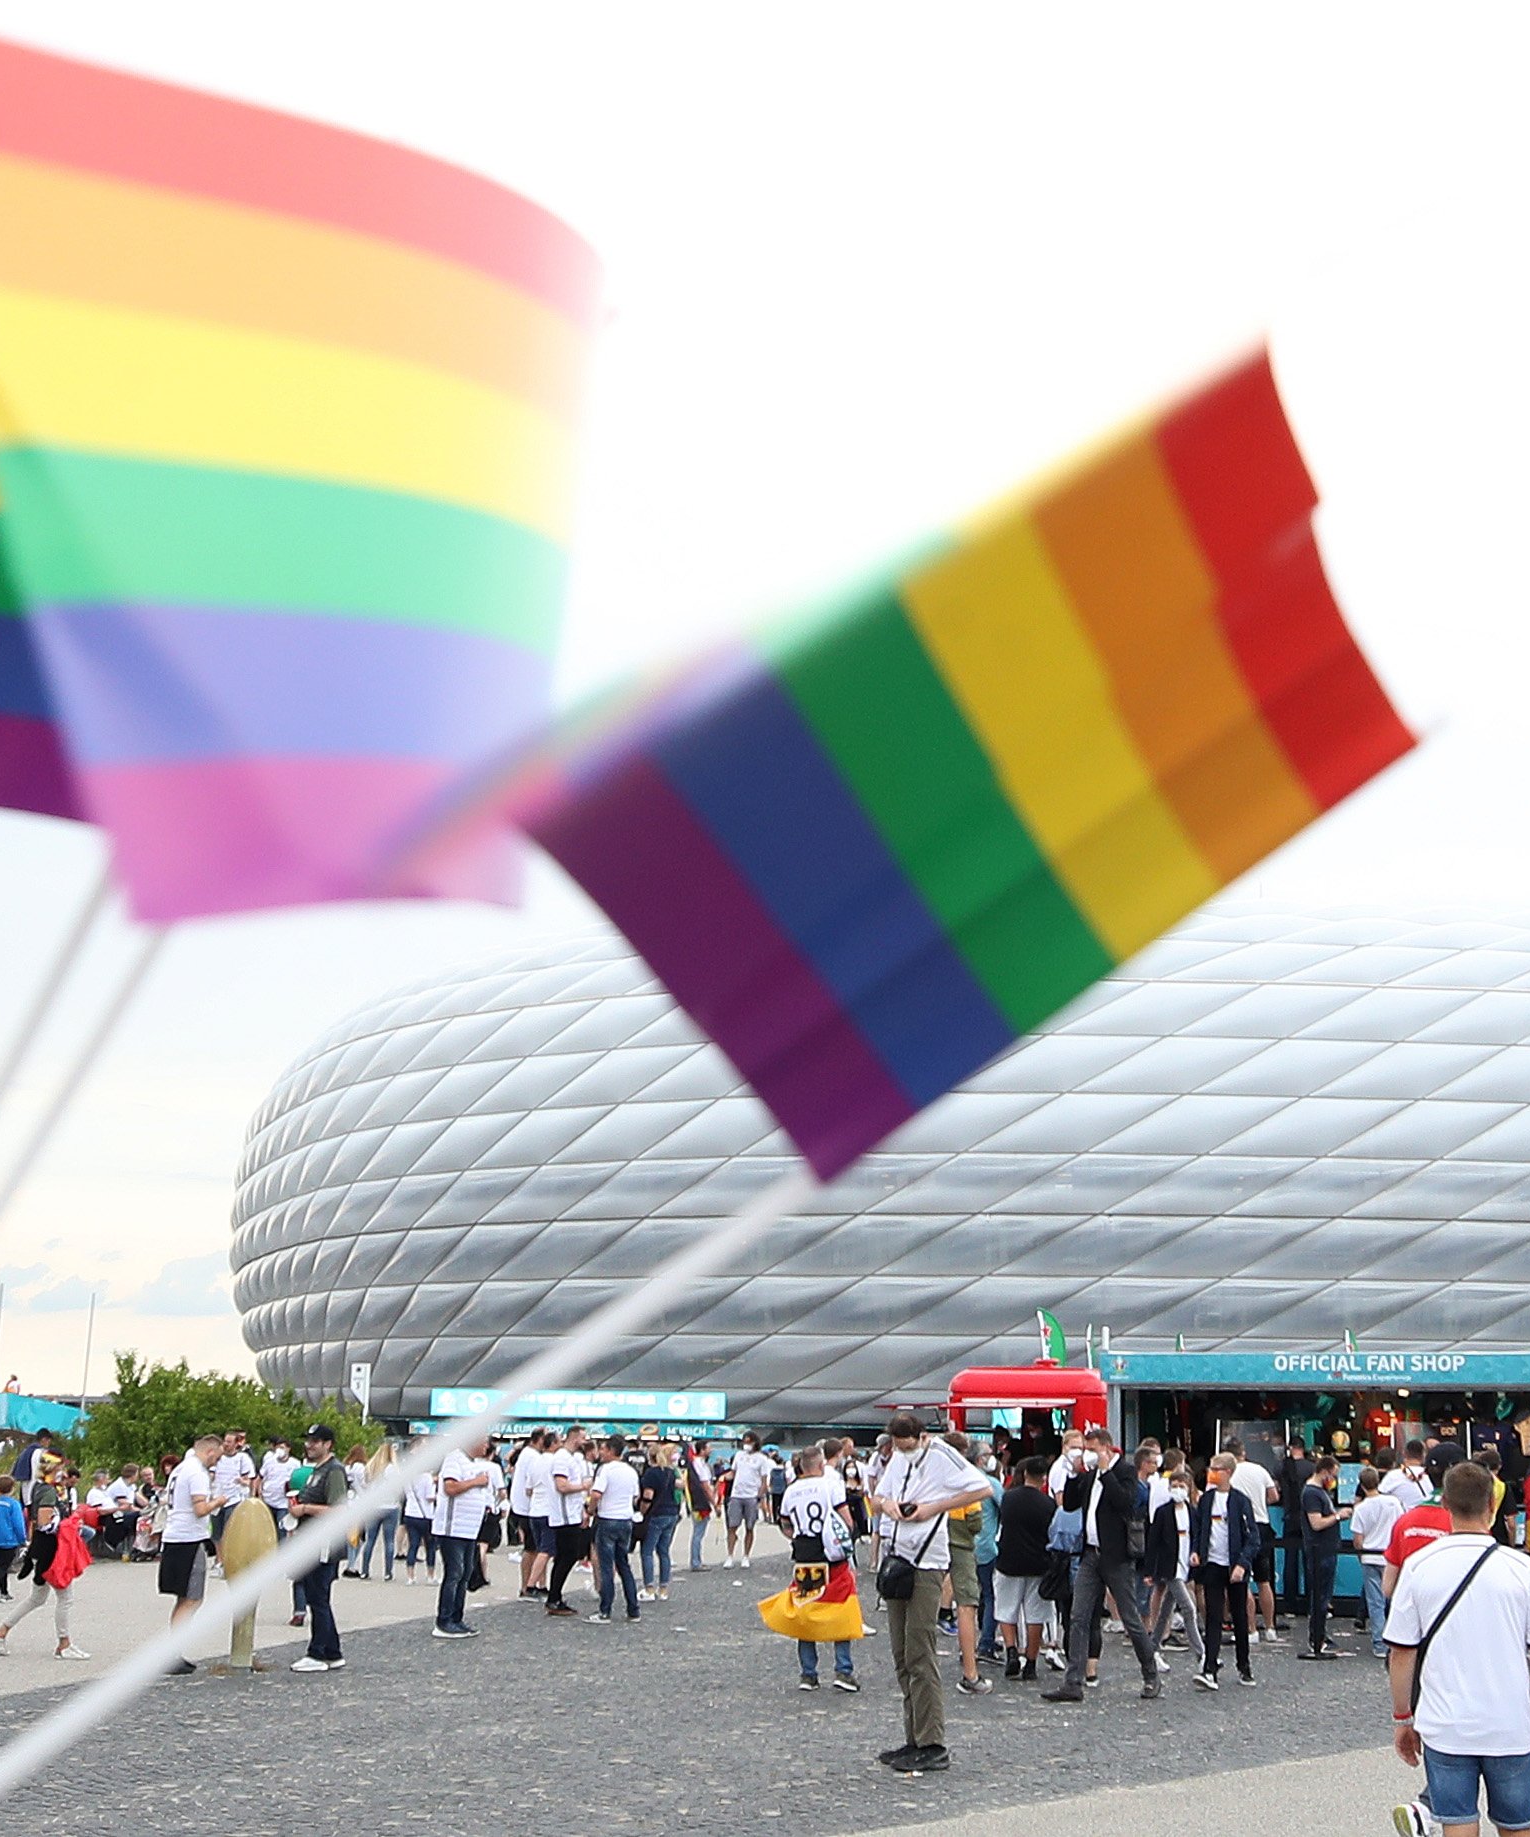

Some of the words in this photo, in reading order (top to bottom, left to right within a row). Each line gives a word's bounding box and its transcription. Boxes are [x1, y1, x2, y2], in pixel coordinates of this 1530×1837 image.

[1274, 1355, 1361, 1372] OFFICIAL
[1367, 1355, 1404, 1372] FAN
[1411, 1355, 1465, 1372] SHOP
[790, 1501, 824, 1535] 18
